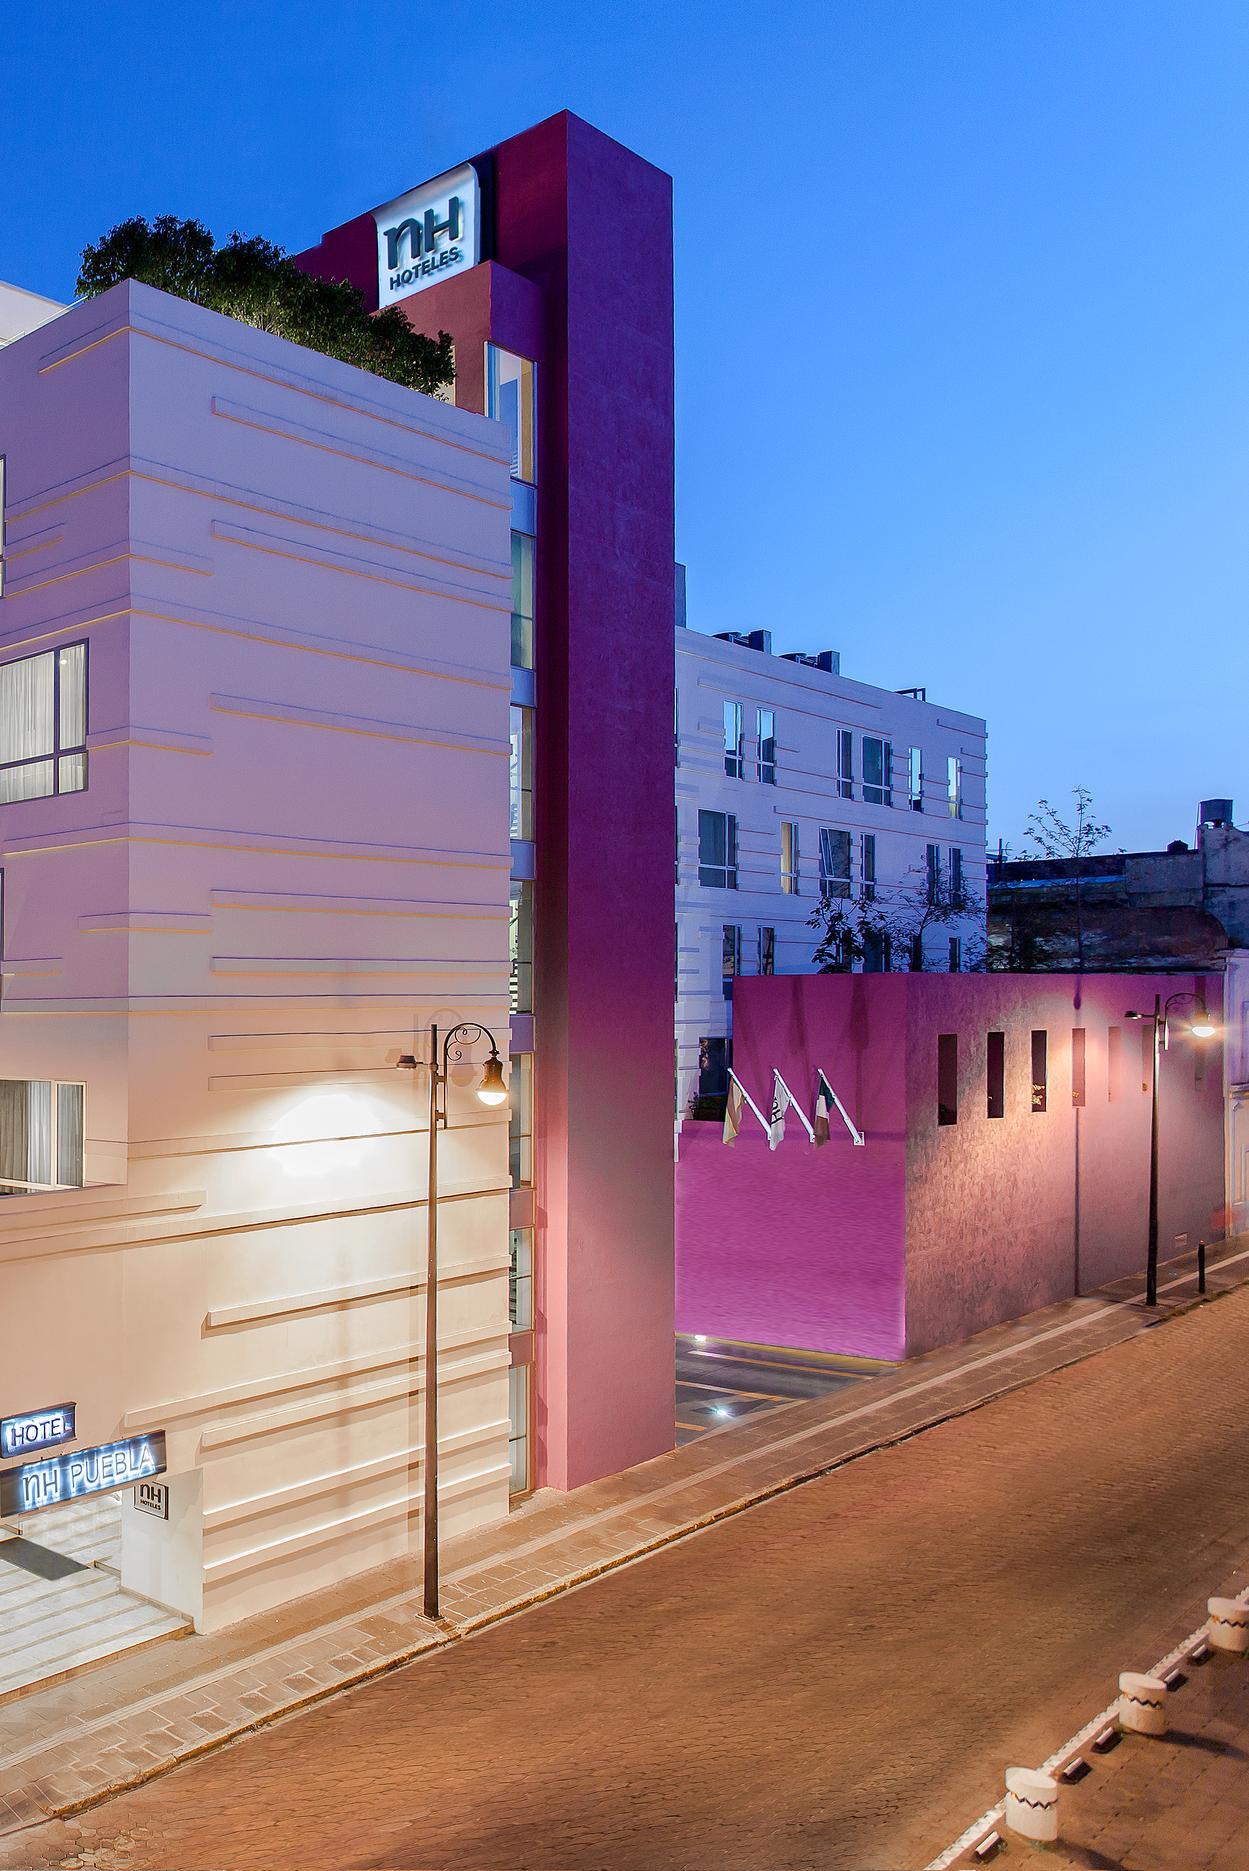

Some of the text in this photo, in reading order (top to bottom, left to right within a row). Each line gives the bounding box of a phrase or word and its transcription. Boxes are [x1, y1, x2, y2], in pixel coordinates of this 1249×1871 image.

[389, 246, 460, 290] HOTELES
[11, 1415, 72, 1447] HOTEL
[70, 1442, 156, 1489] PUEBLA
[140, 1498, 162, 1511] HOTELES
